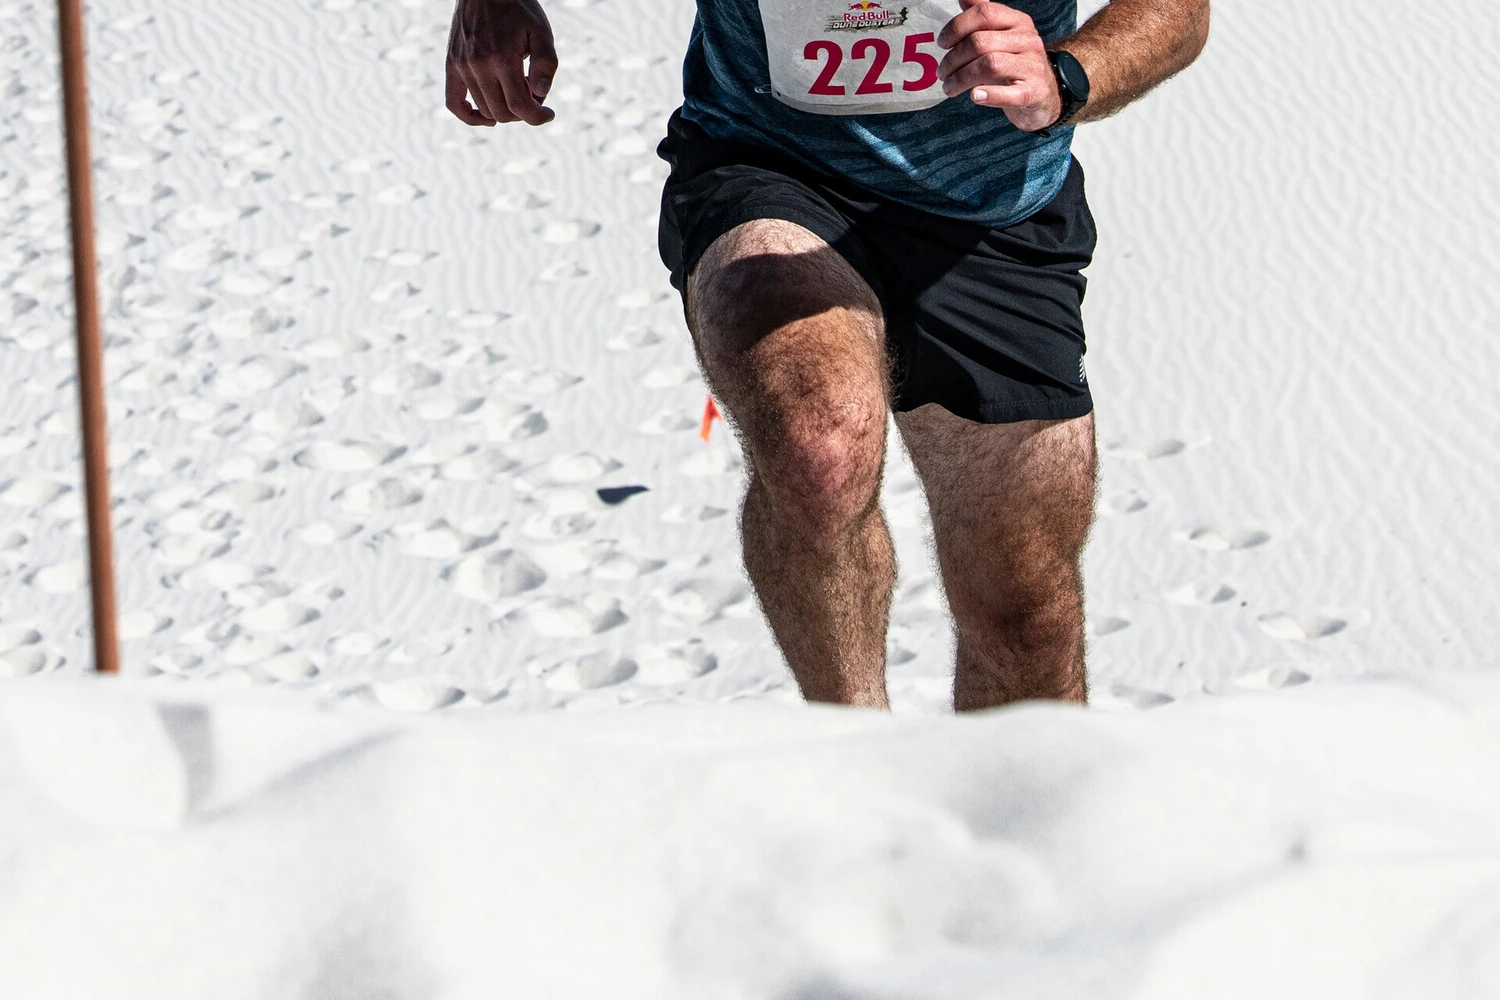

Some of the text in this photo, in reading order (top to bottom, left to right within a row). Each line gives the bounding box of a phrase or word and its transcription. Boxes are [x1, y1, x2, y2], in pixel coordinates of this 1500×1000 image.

[843, 10, 889, 22] Red Bull
[803, 32, 939, 96] 225
